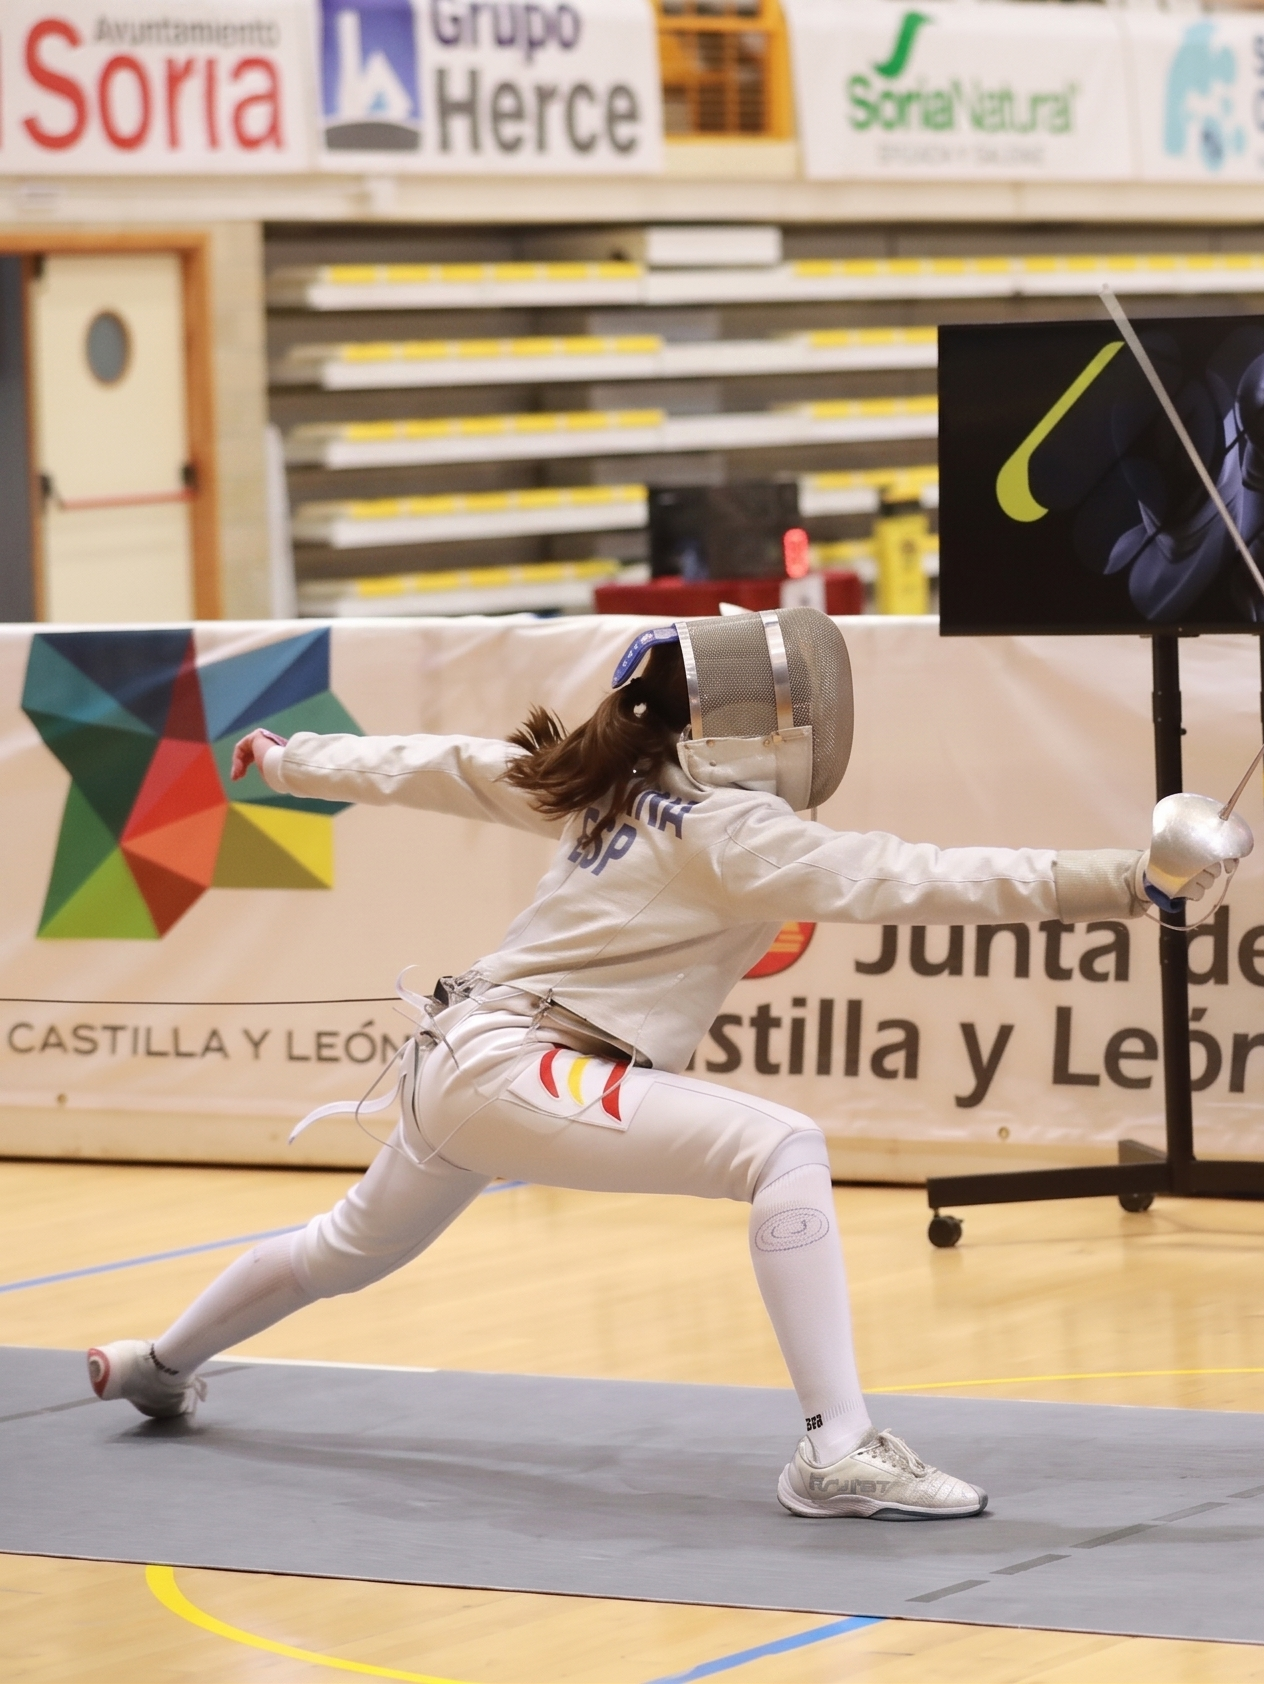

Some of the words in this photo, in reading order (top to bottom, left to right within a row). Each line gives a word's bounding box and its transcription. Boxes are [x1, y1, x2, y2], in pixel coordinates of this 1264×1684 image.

[94, 16, 282, 48] Ayuntamiento
[430, 0, 583, 64] Grupo
[23, 17, 288, 152] Soria
[433, 66, 640, 156] Herce
[854, 919, 1131, 982] Junta
[8, 1021, 230, 1060] CASTILLA
[243, 1028, 271, 1060] Y
[685, 996, 920, 1080] stilla
[955, 1018, 1015, 1109] y
